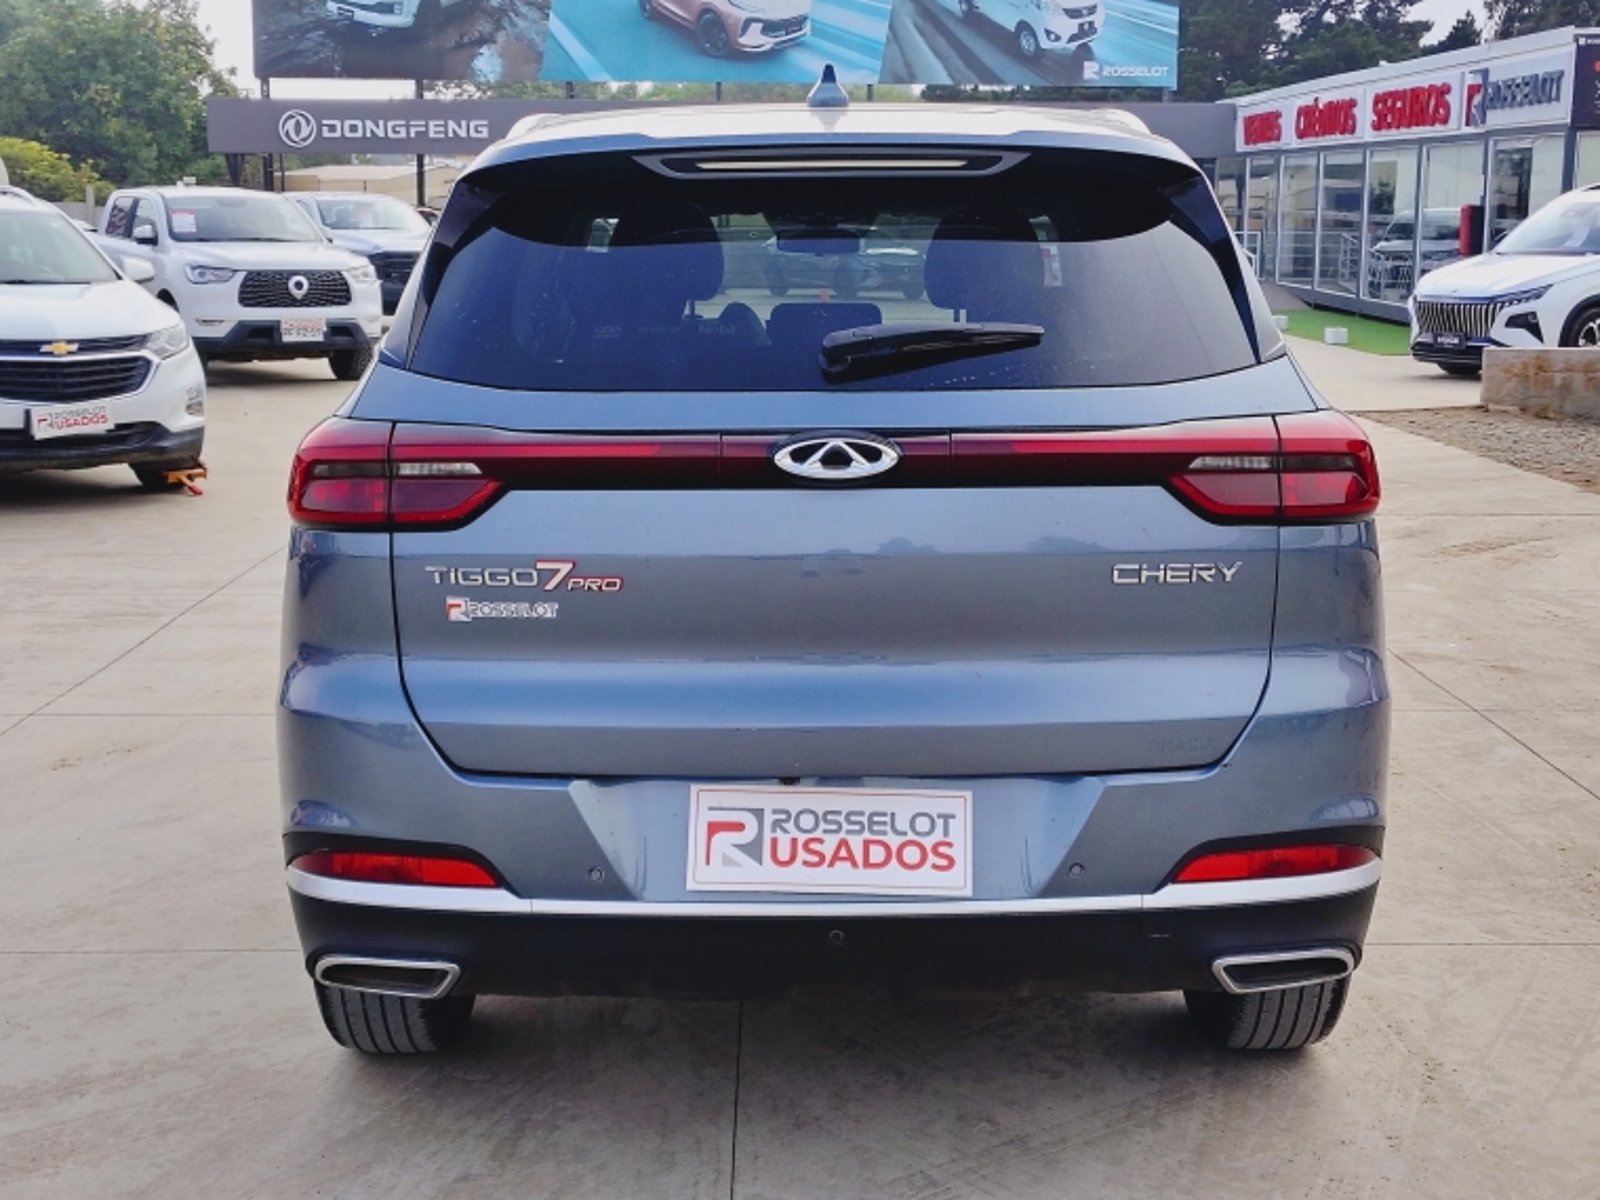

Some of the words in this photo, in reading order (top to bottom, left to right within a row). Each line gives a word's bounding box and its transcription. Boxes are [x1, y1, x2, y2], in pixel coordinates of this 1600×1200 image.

[1103, 66, 1168, 76] ROSSELOT
[321, 119, 489, 139] DONGFENG
[55, 414, 108, 430] USADOS
[425, 566, 538, 587] TIGGO
[567, 577, 623, 592] PRO
[1112, 561, 1243, 584] CHERY
[770, 808, 956, 838] ROSSELOT
[769, 836, 956, 872] USADOS
